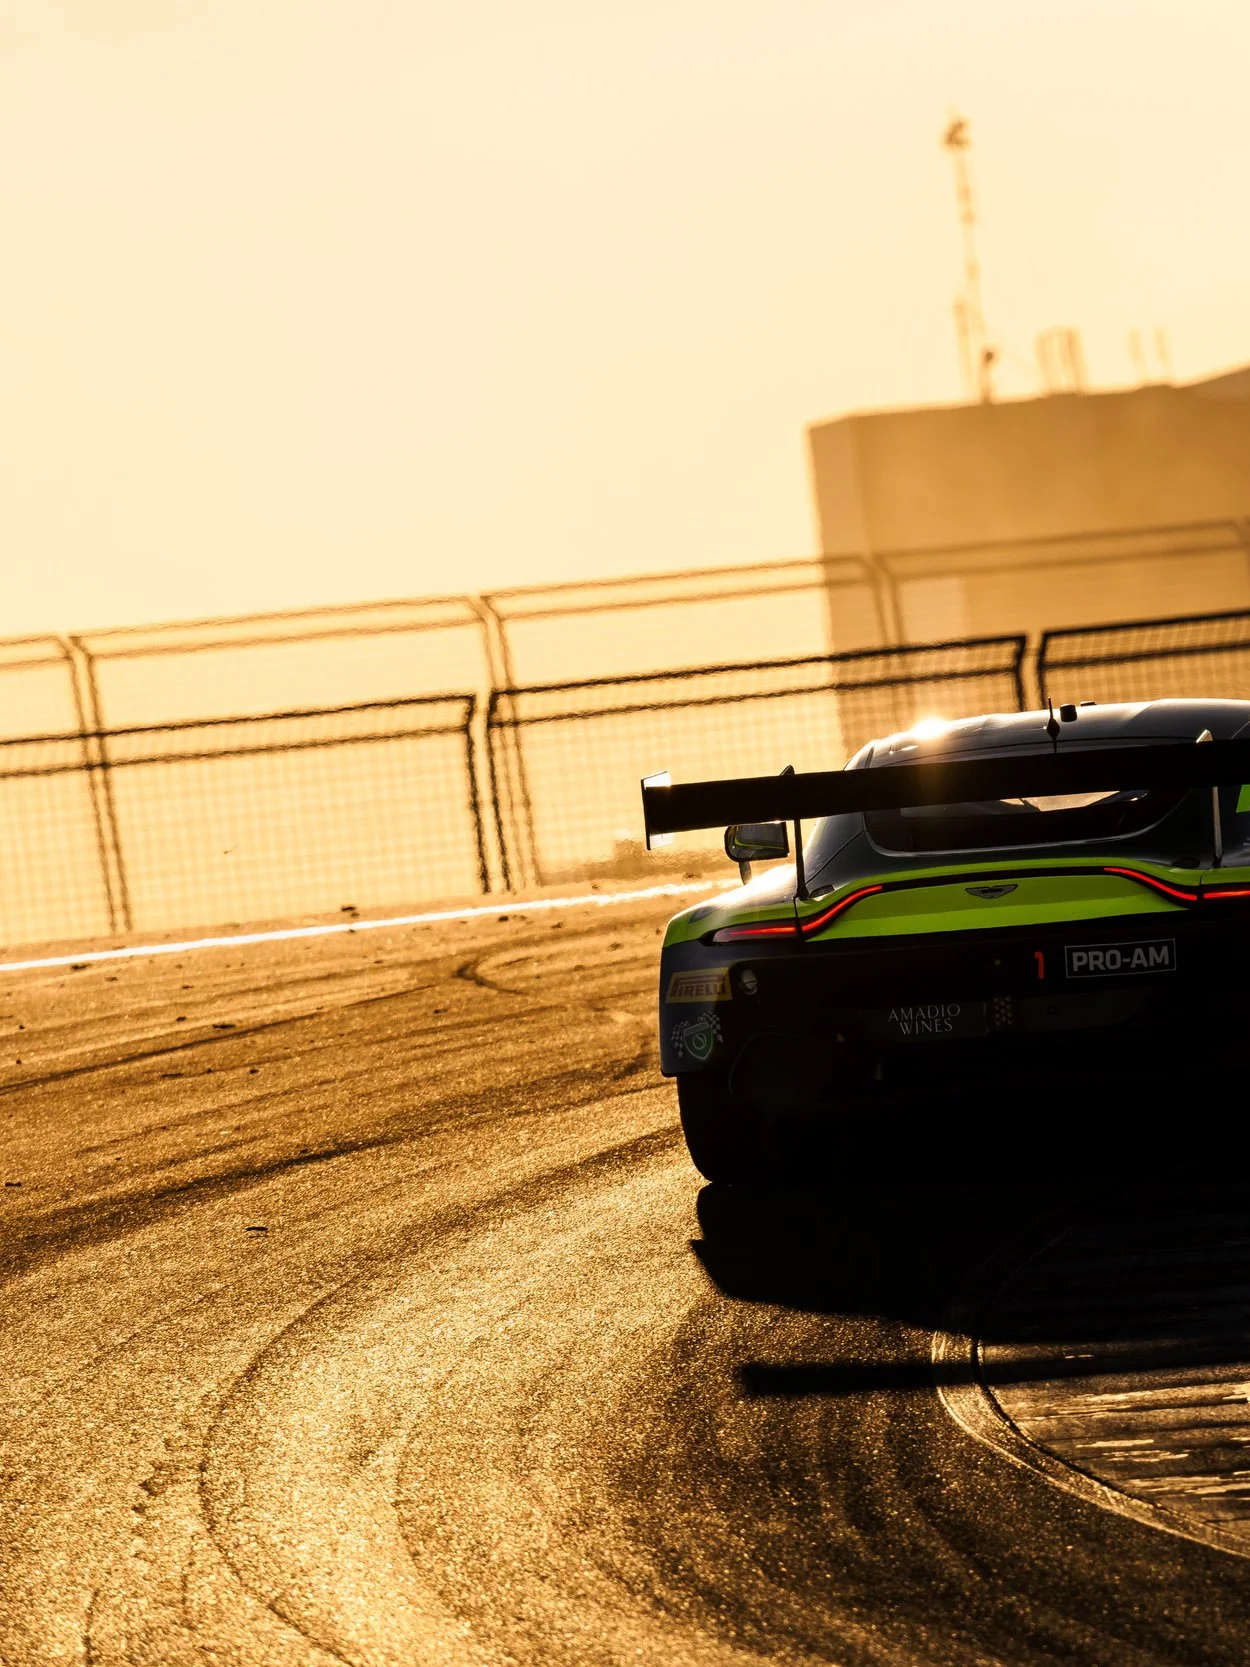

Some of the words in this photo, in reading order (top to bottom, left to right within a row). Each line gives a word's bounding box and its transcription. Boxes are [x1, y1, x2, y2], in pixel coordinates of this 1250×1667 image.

[1033, 950, 1045, 980] 1
[1071, 945, 1171, 972] PRO-AM
[670, 974, 727, 997] PIRELLI
[887, 1002, 961, 1023] AMADIO
[899, 1017, 953, 1035] WINES
